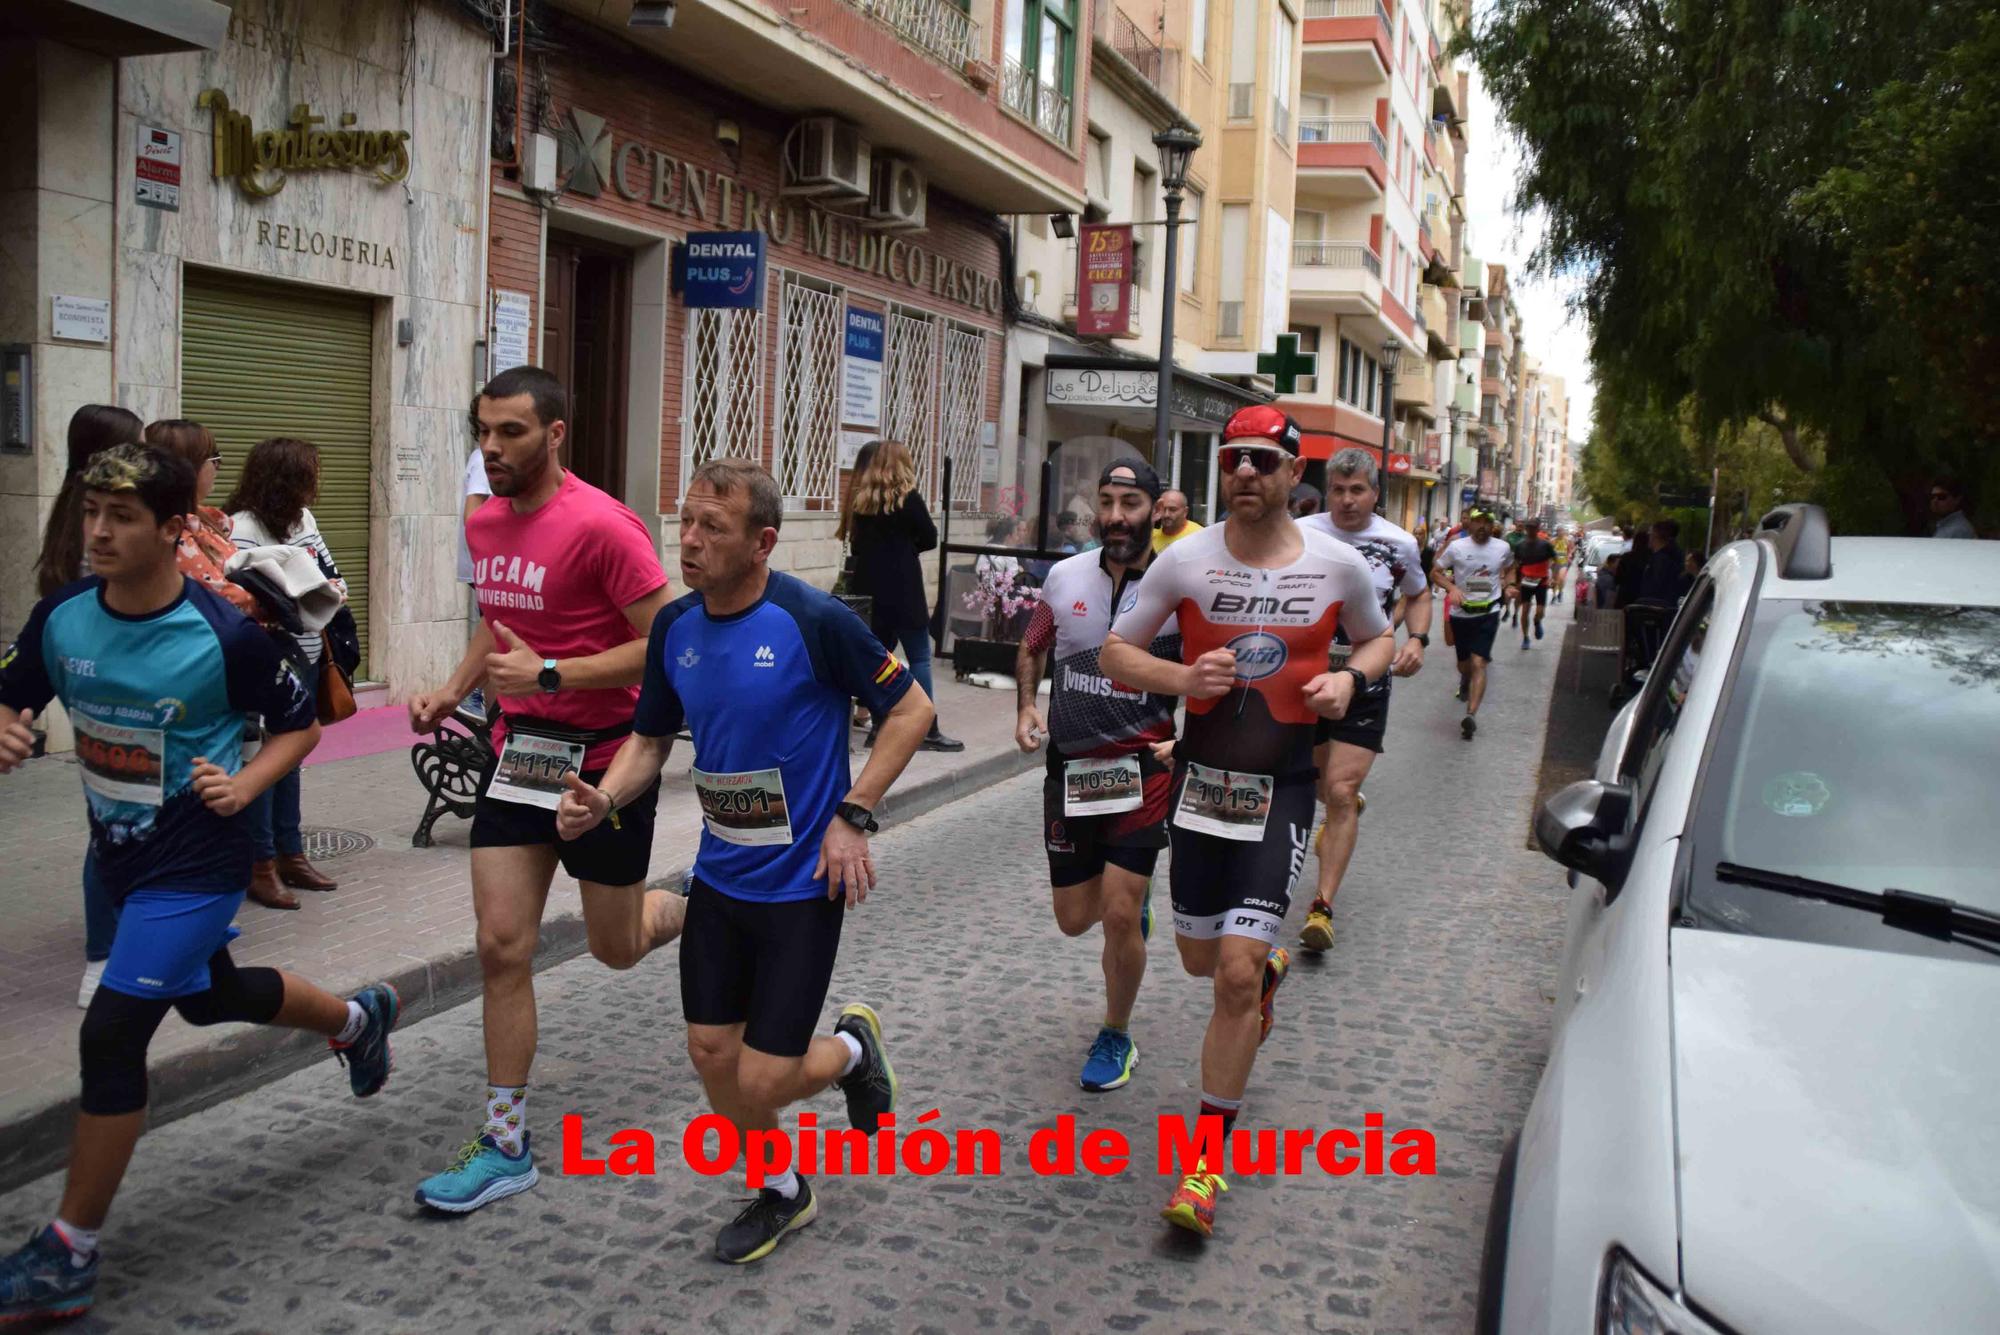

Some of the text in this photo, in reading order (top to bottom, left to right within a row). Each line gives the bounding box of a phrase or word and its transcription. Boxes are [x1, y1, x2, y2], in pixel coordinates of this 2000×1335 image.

[197, 88, 411, 197] Montesinos
[615, 141, 1001, 314] CENTRO MEDICO PASEO
[257, 219, 395, 270] RELOJERIA
[689, 243, 756, 257] DENTAL
[687, 267, 730, 281] PLUS
[59, 312, 104, 324] ECONOMISTA
[849, 313, 882, 333] DENTAL
[848, 332, 870, 349] PLUS
[1048, 370, 1158, 400] Las Delicias
[476, 555, 547, 593] UCAM
[1206, 569, 1252, 580] POLAR
[511, 751, 573, 780] 1117
[1075, 767, 1132, 791] 1054
[1198, 782, 1261, 812] 1015
[1242, 897, 1281, 910] CRAFT
[1235, 916, 1260, 928] DT
